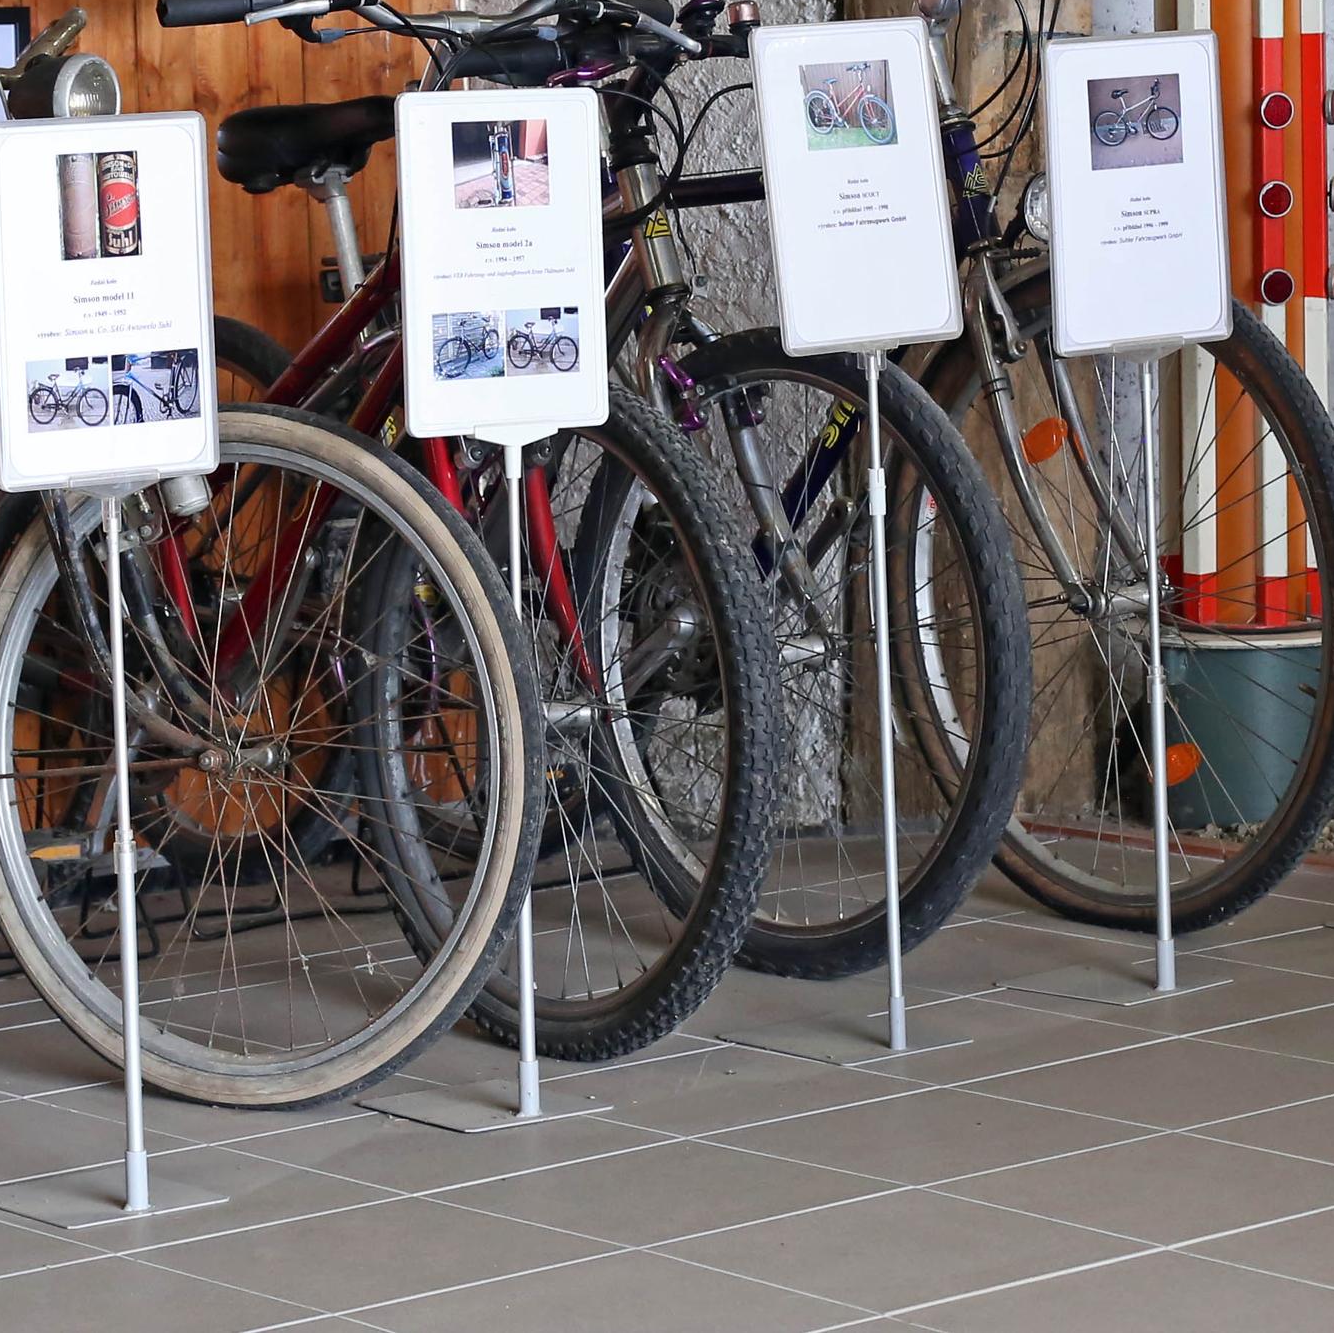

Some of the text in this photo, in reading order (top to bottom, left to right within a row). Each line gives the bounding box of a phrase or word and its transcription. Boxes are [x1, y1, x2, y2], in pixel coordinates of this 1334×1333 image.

[1121, 210, 1142, 218] Simson
[476, 241, 501, 250] Simson
[503, 240, 523, 248] model
[73, 291, 135, 304] Simson model 11
